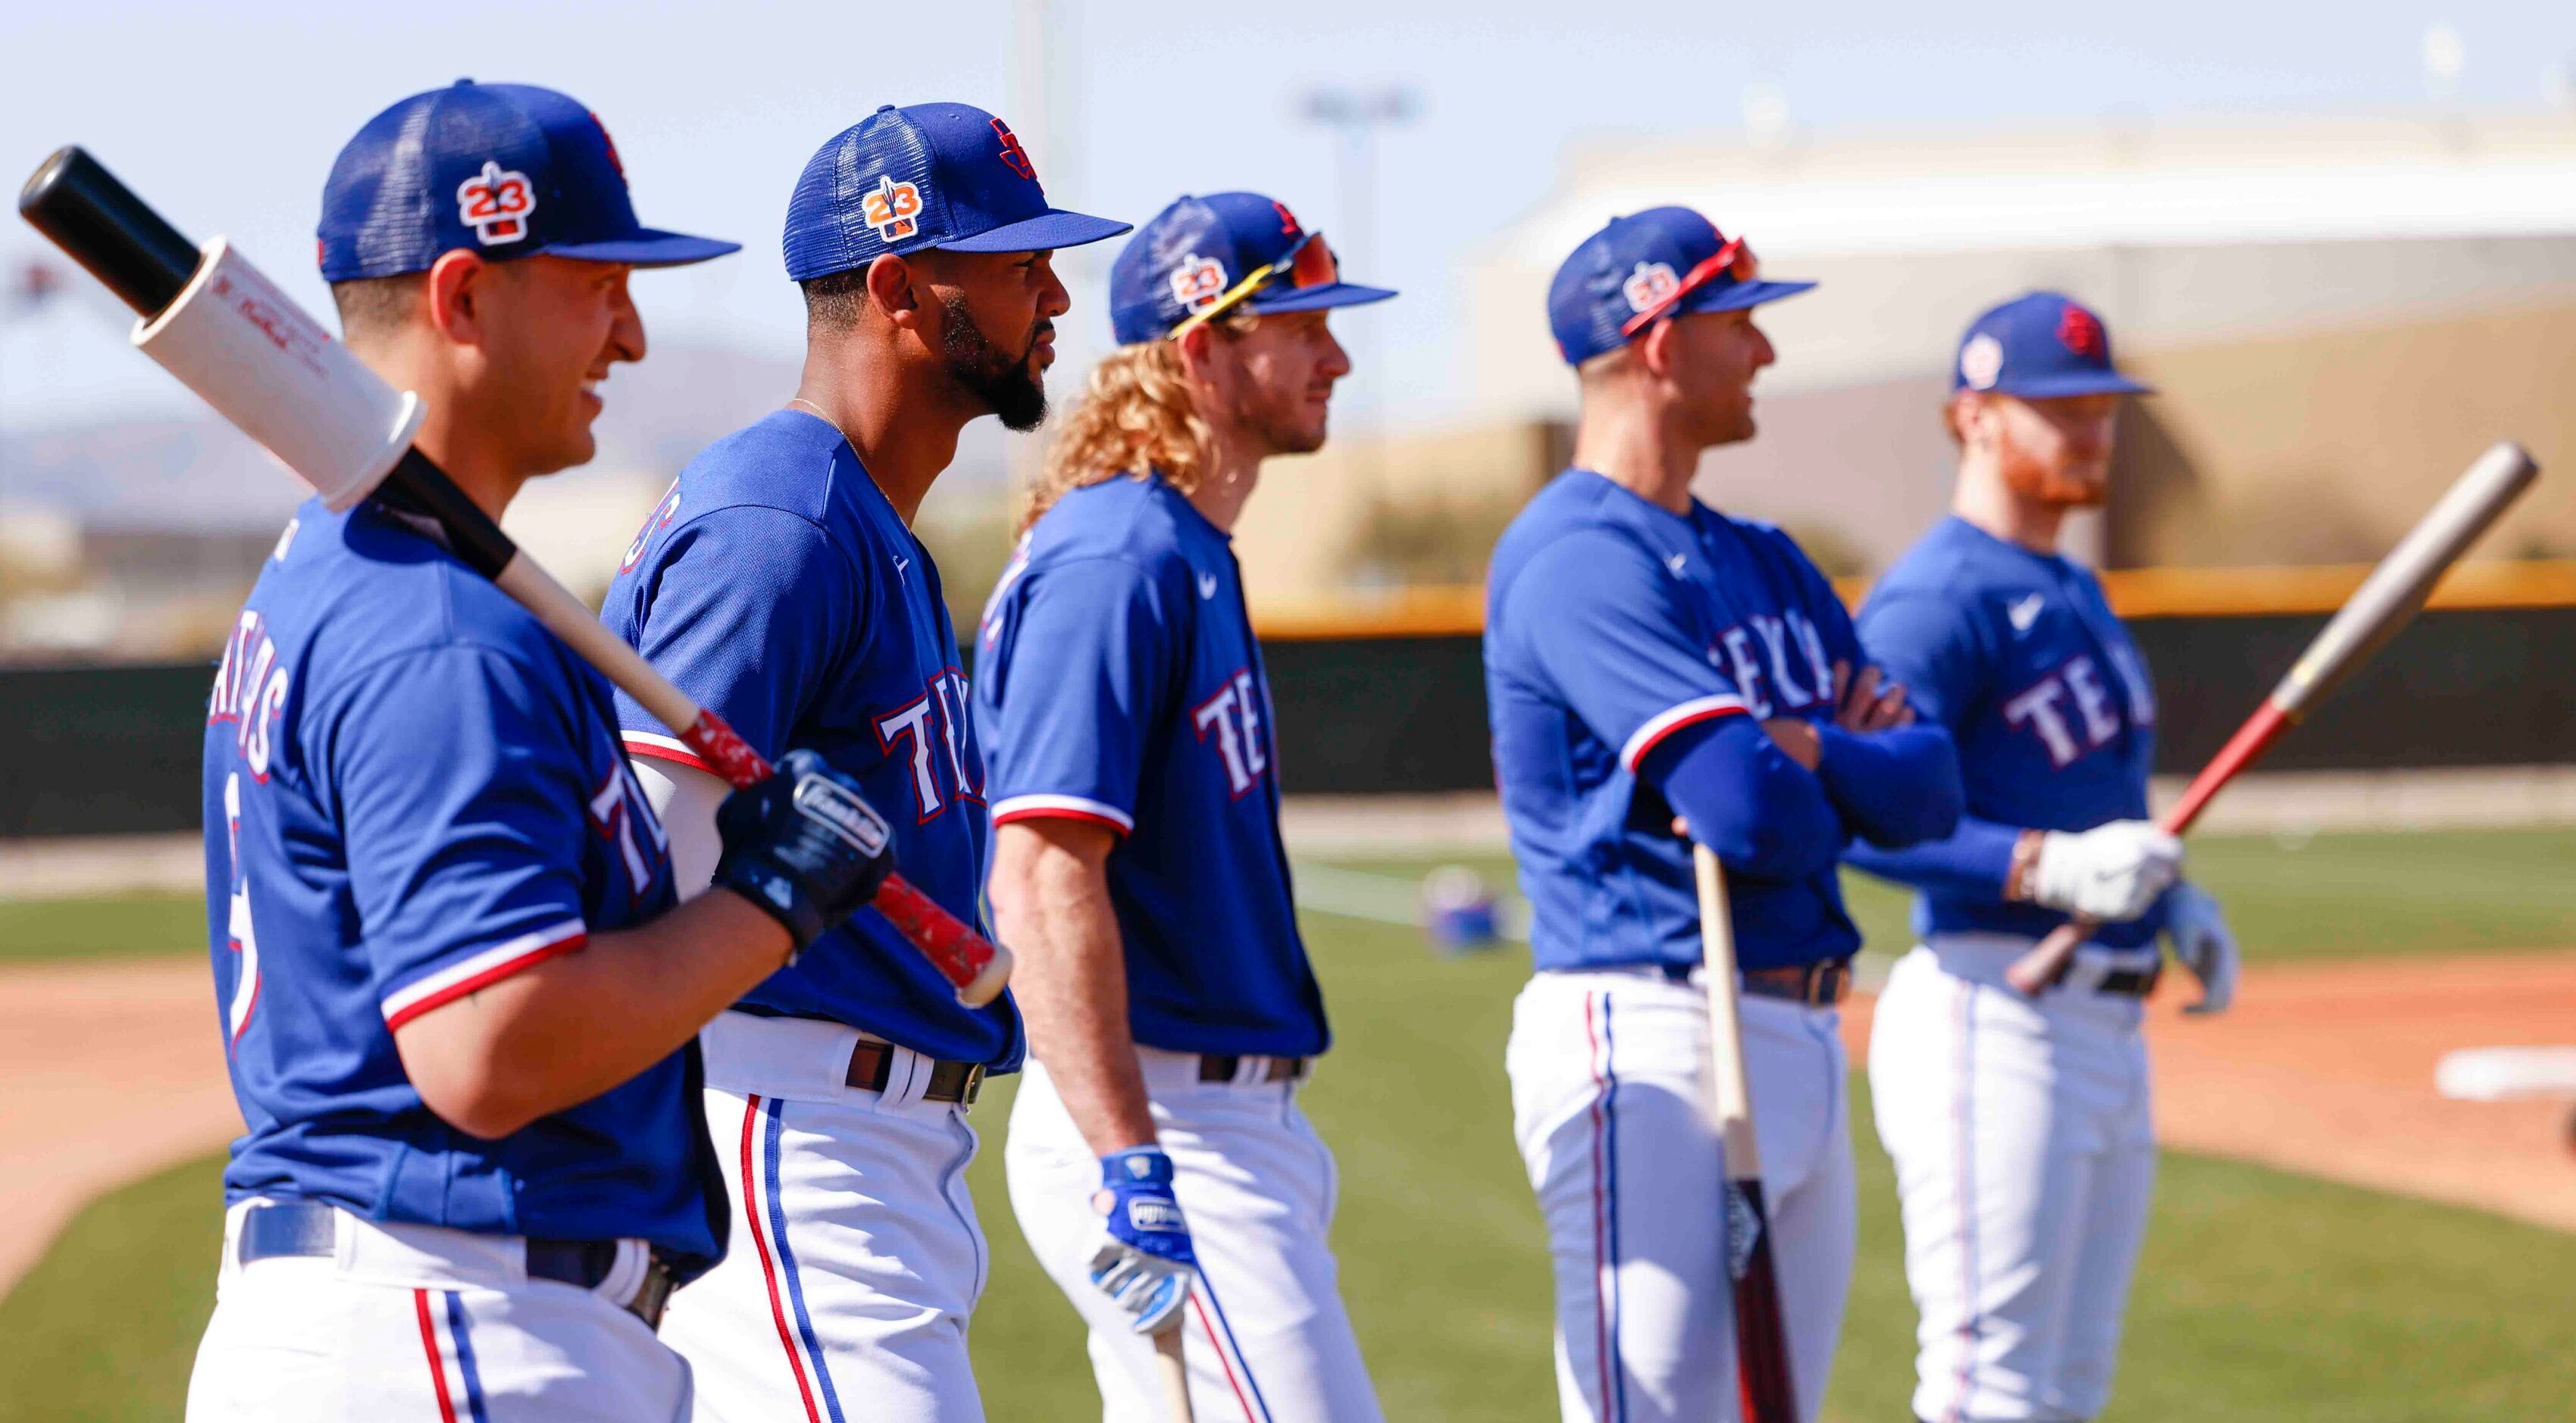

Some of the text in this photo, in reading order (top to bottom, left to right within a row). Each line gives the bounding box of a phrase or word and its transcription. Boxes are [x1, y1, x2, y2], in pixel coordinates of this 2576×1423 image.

[464, 178, 530, 218] 23
[865, 185, 919, 225] 23
[1176, 264, 1221, 296] 23
[1999, 643, 2155, 771] TE
